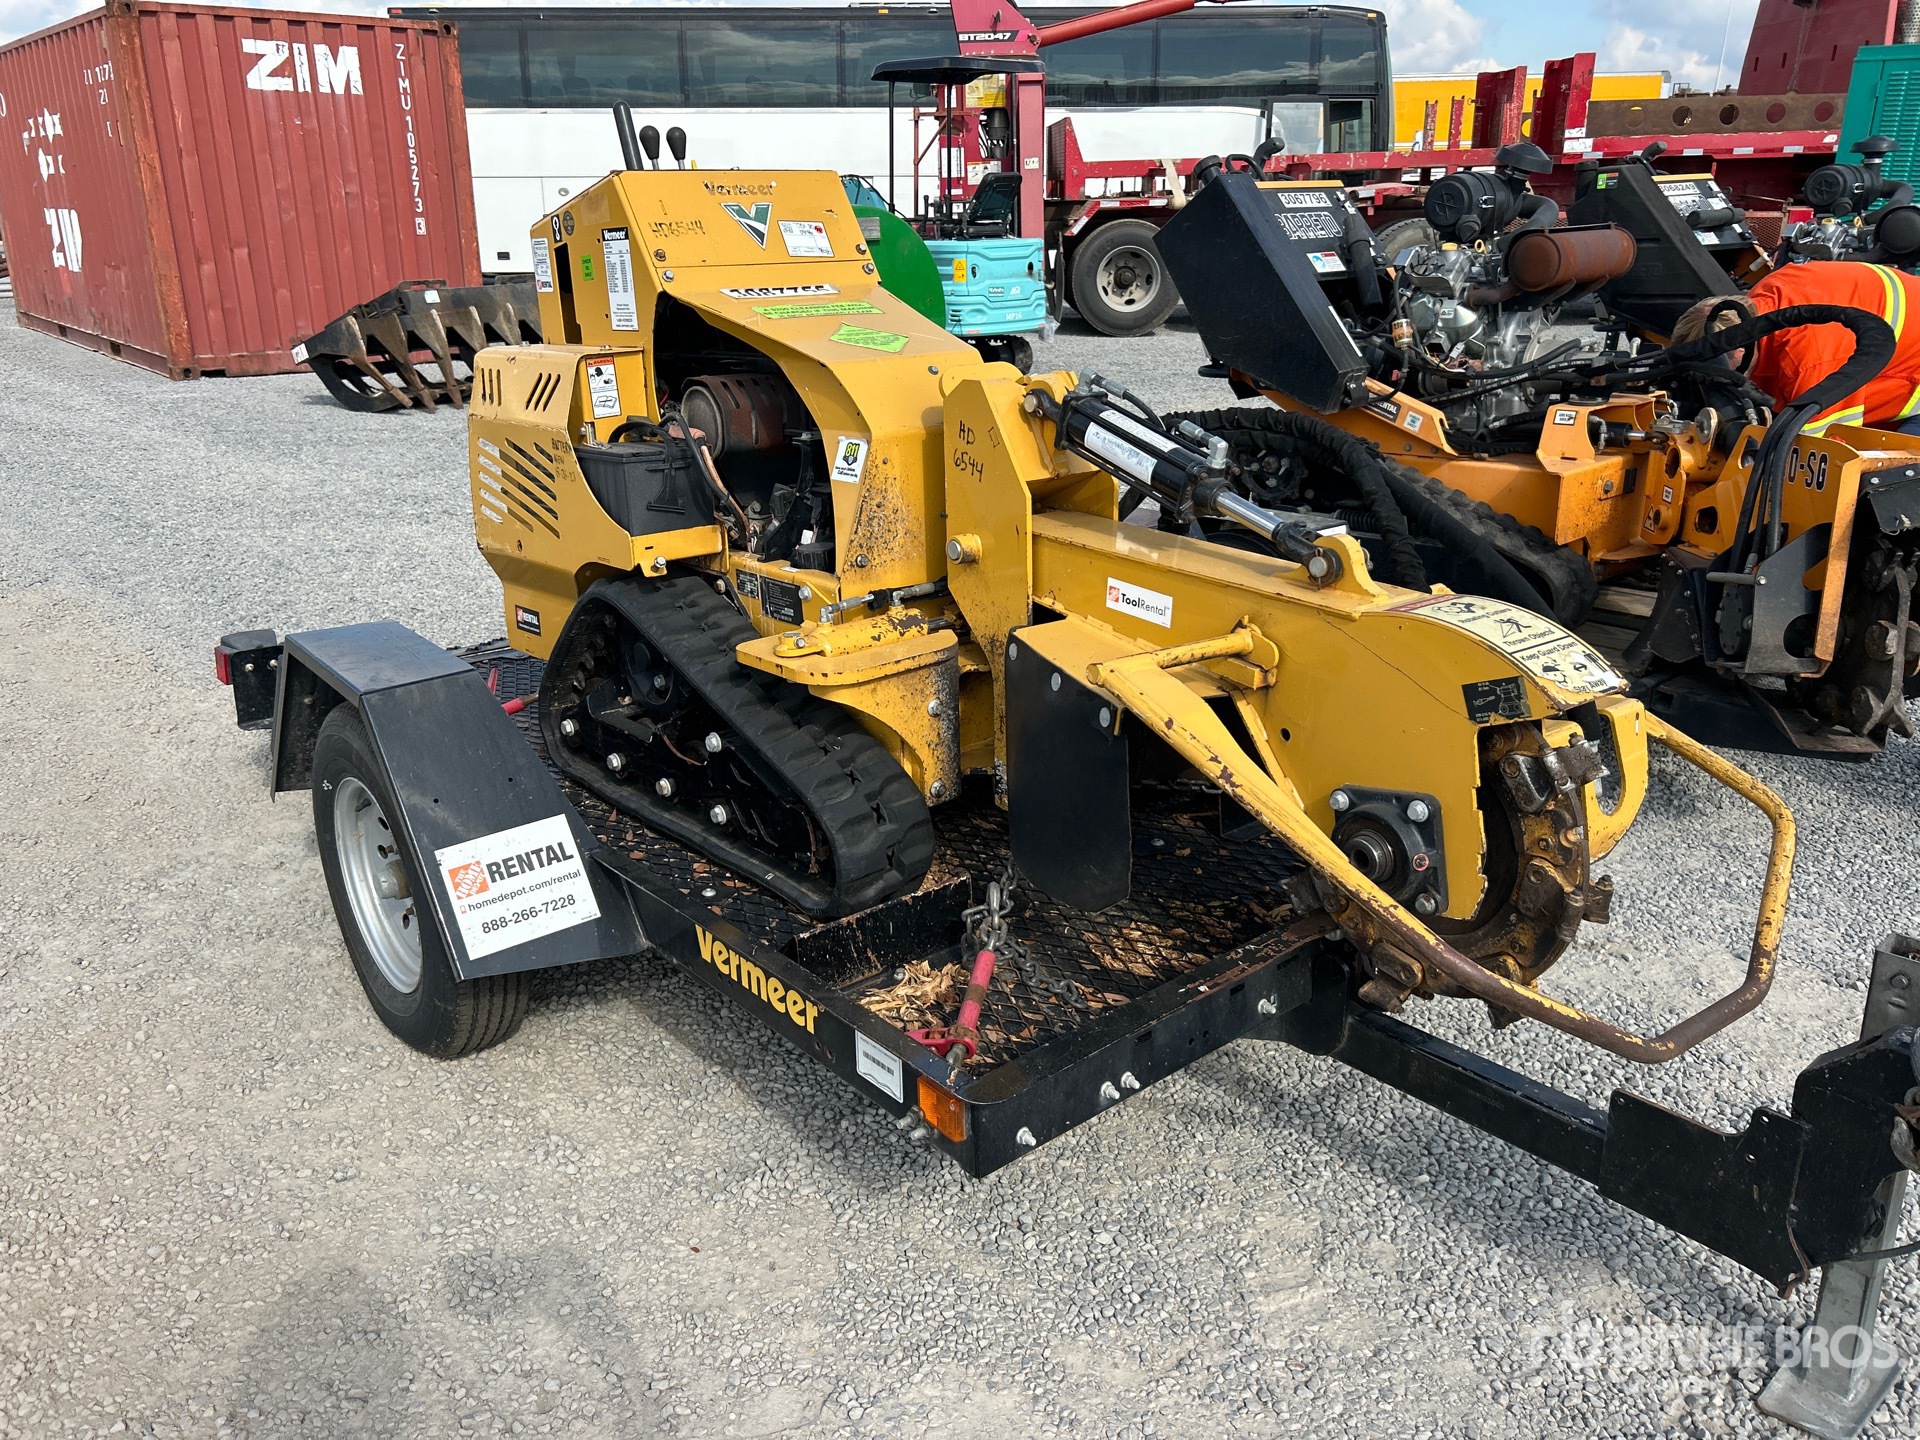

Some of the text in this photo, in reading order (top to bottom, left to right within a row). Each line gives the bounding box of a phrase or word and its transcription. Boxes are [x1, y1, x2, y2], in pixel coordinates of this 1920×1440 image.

[958, 32, 1012, 42] BT2047
[241, 38, 364, 95] ZIM
[395, 43, 411, 111] ZIMU
[405, 115, 424, 213] 105273
[1280, 193, 1328, 205] 3067796
[603, 229, 627, 241] Vermeer
[1275, 211, 1343, 241] BARRETO
[958, 420, 976, 445] HD
[846, 442, 860, 457] 811
[953, 448, 984, 482] 6544
[1502, 627, 1556, 648] Thrown Objects
[1520, 641, 1579, 662] Keep Guard Down
[486, 841, 574, 884] RENTAL
[456, 860, 482, 899] HOME
[468, 869, 582, 912] homedepot.com/rental
[481, 893, 577, 935] 888-266-7228
[695, 923, 820, 1035] Vermeer
